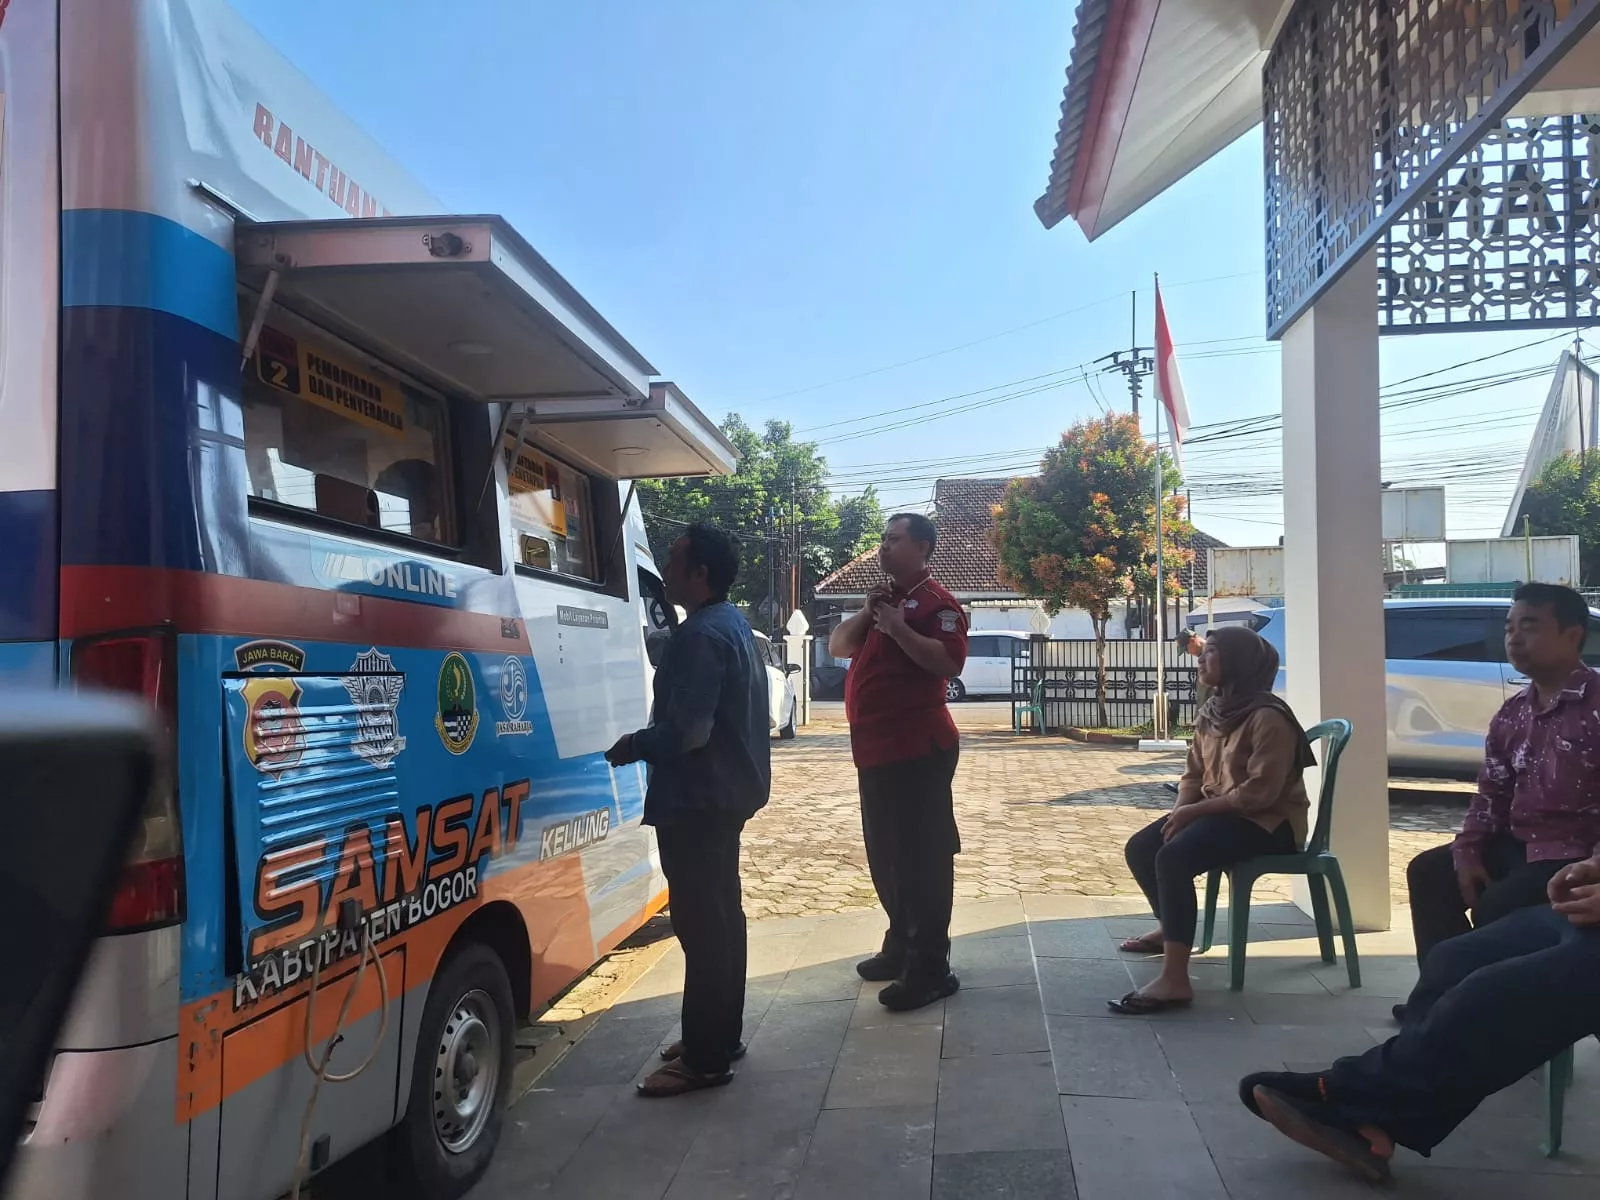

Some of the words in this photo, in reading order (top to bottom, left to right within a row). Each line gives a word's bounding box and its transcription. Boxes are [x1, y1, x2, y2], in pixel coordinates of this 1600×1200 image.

[270, 360, 289, 388] 2
[309, 374, 334, 402] DAN
[366, 556, 458, 599] ONLINE
[242, 648, 268, 664] JAWA
[270, 648, 300, 665] BARAT
[540, 809, 609, 861] KELILING
[252, 778, 530, 957] SAMSAT
[235, 902, 402, 1008] KABUPAEN
[408, 866, 477, 925] BOGOR
